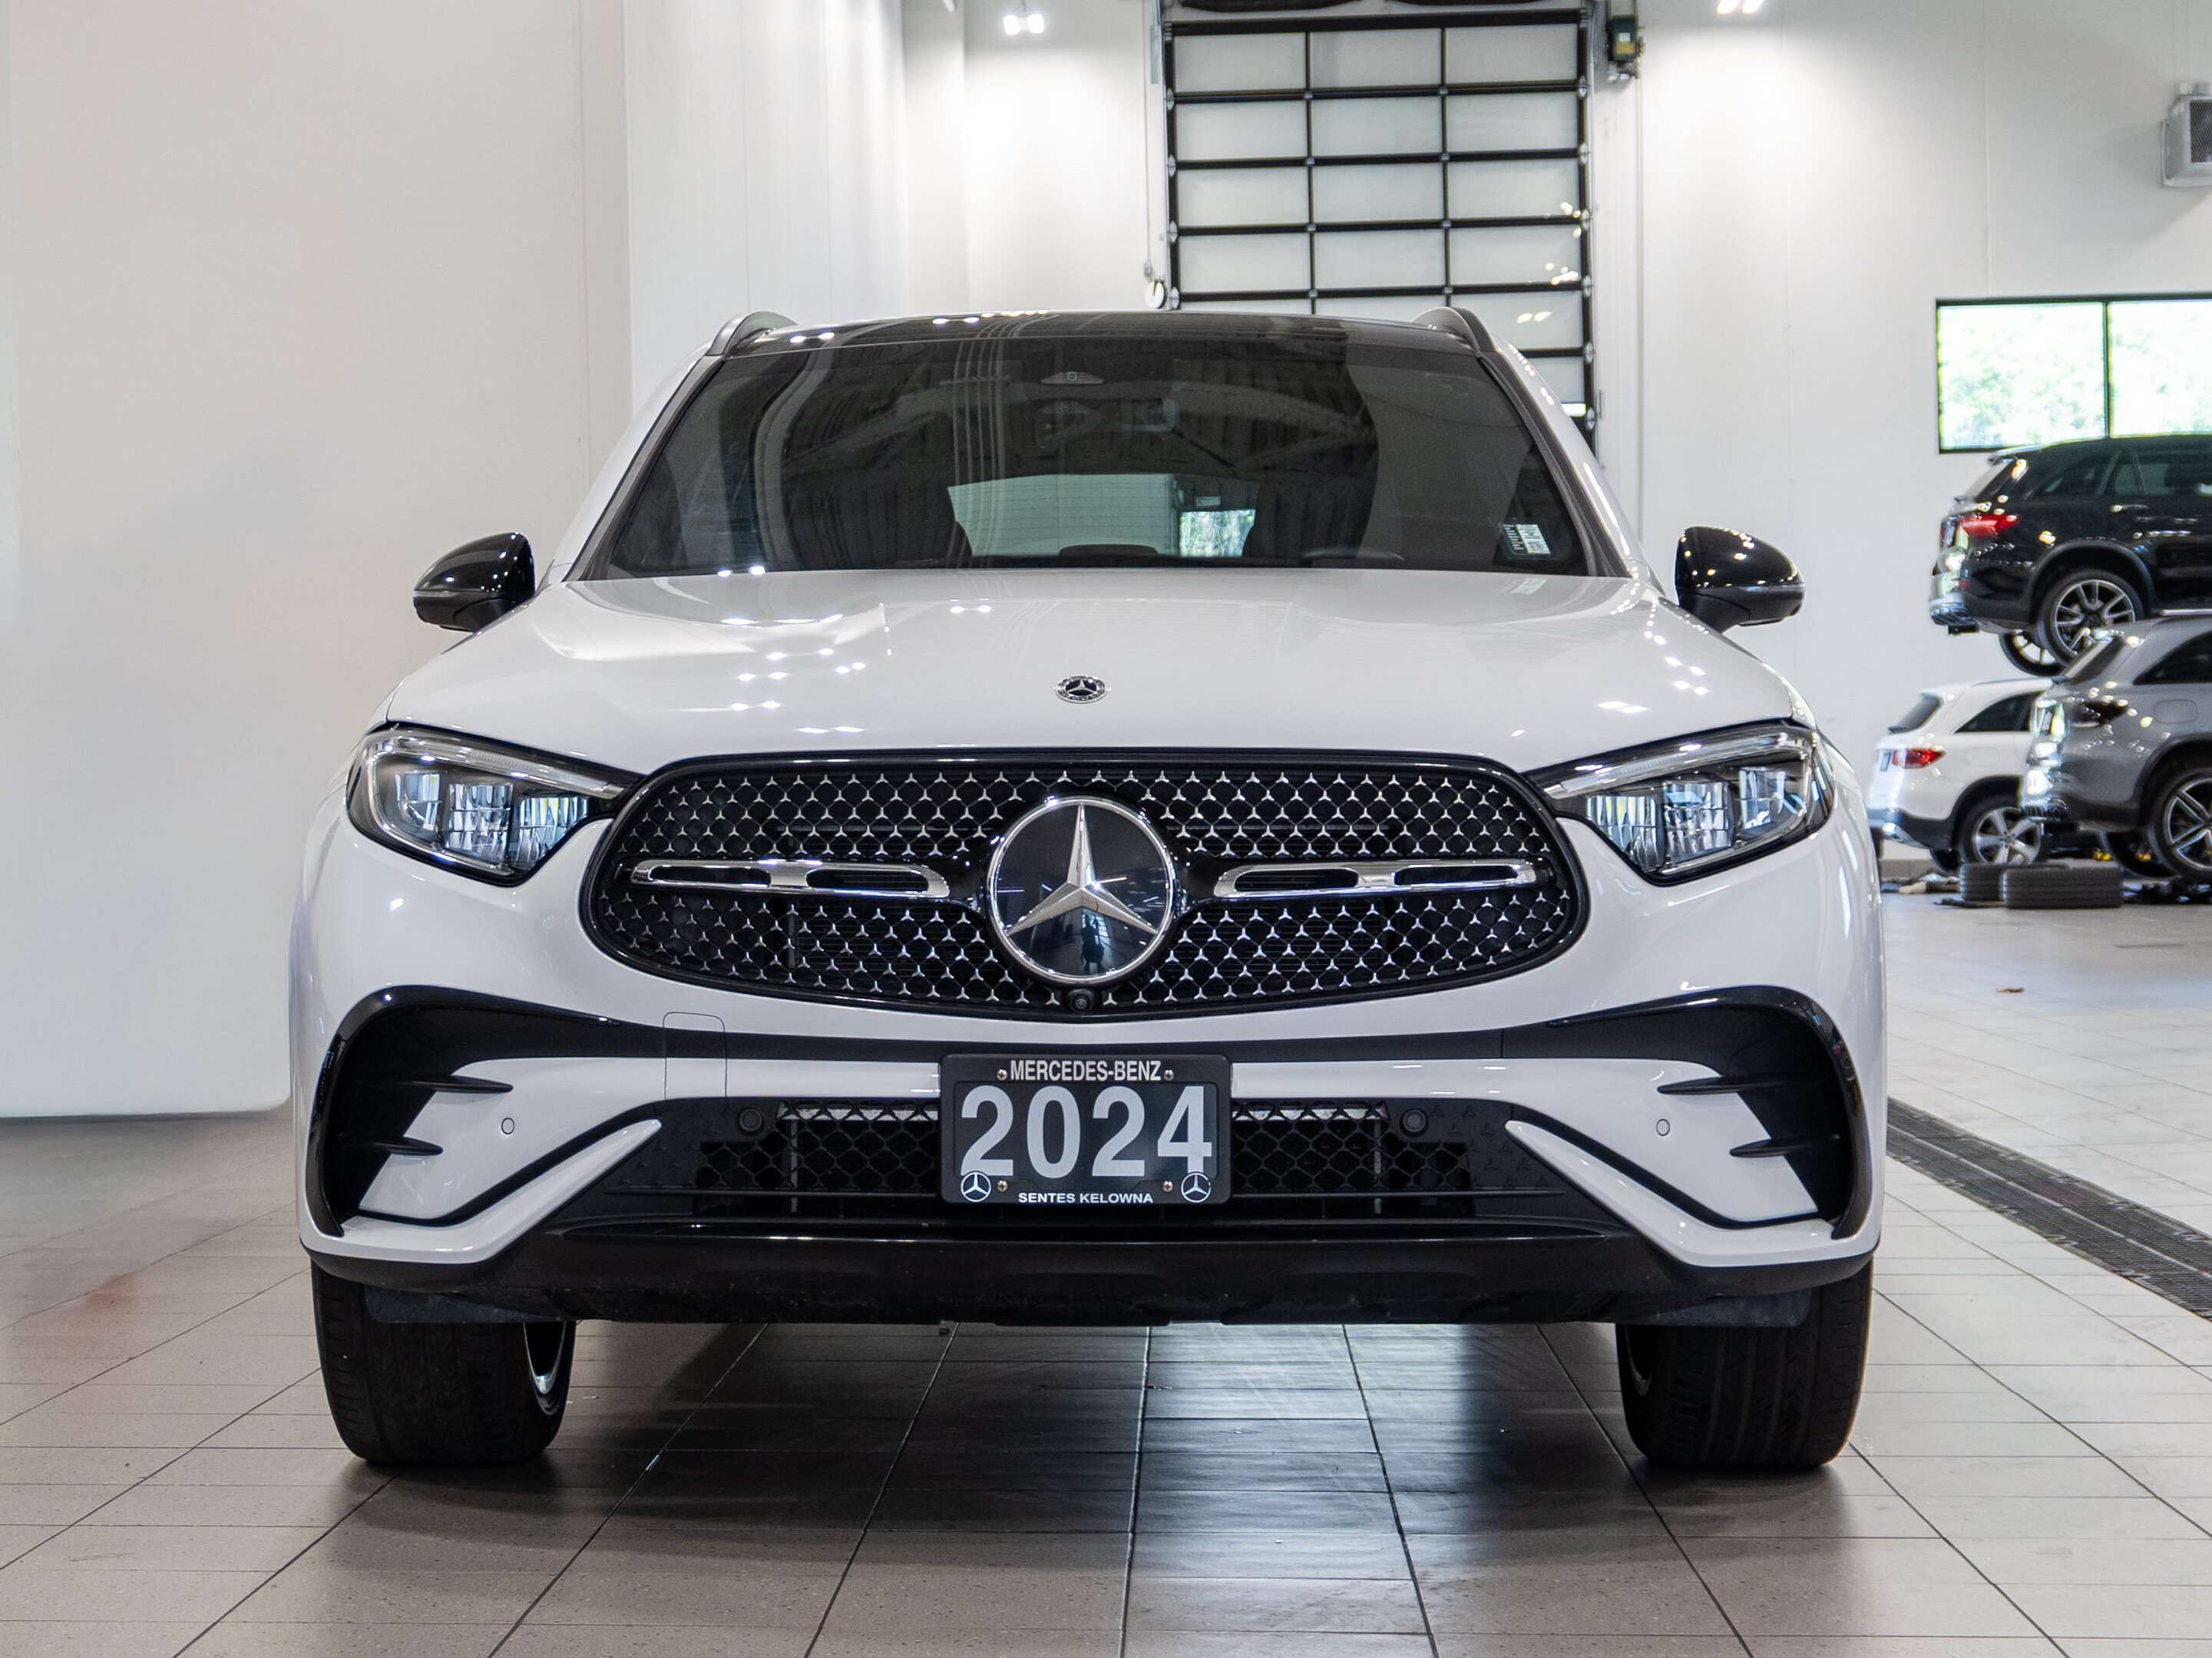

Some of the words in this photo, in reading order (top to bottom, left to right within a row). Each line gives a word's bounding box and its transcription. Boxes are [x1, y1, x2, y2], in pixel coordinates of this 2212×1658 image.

[1010, 1059, 1162, 1082] MERCEDES-BENZ
[961, 1085, 1212, 1179] 2024
[1018, 1192, 1075, 1204] SENTES
[1080, 1192, 1154, 1204] KELOWNA
